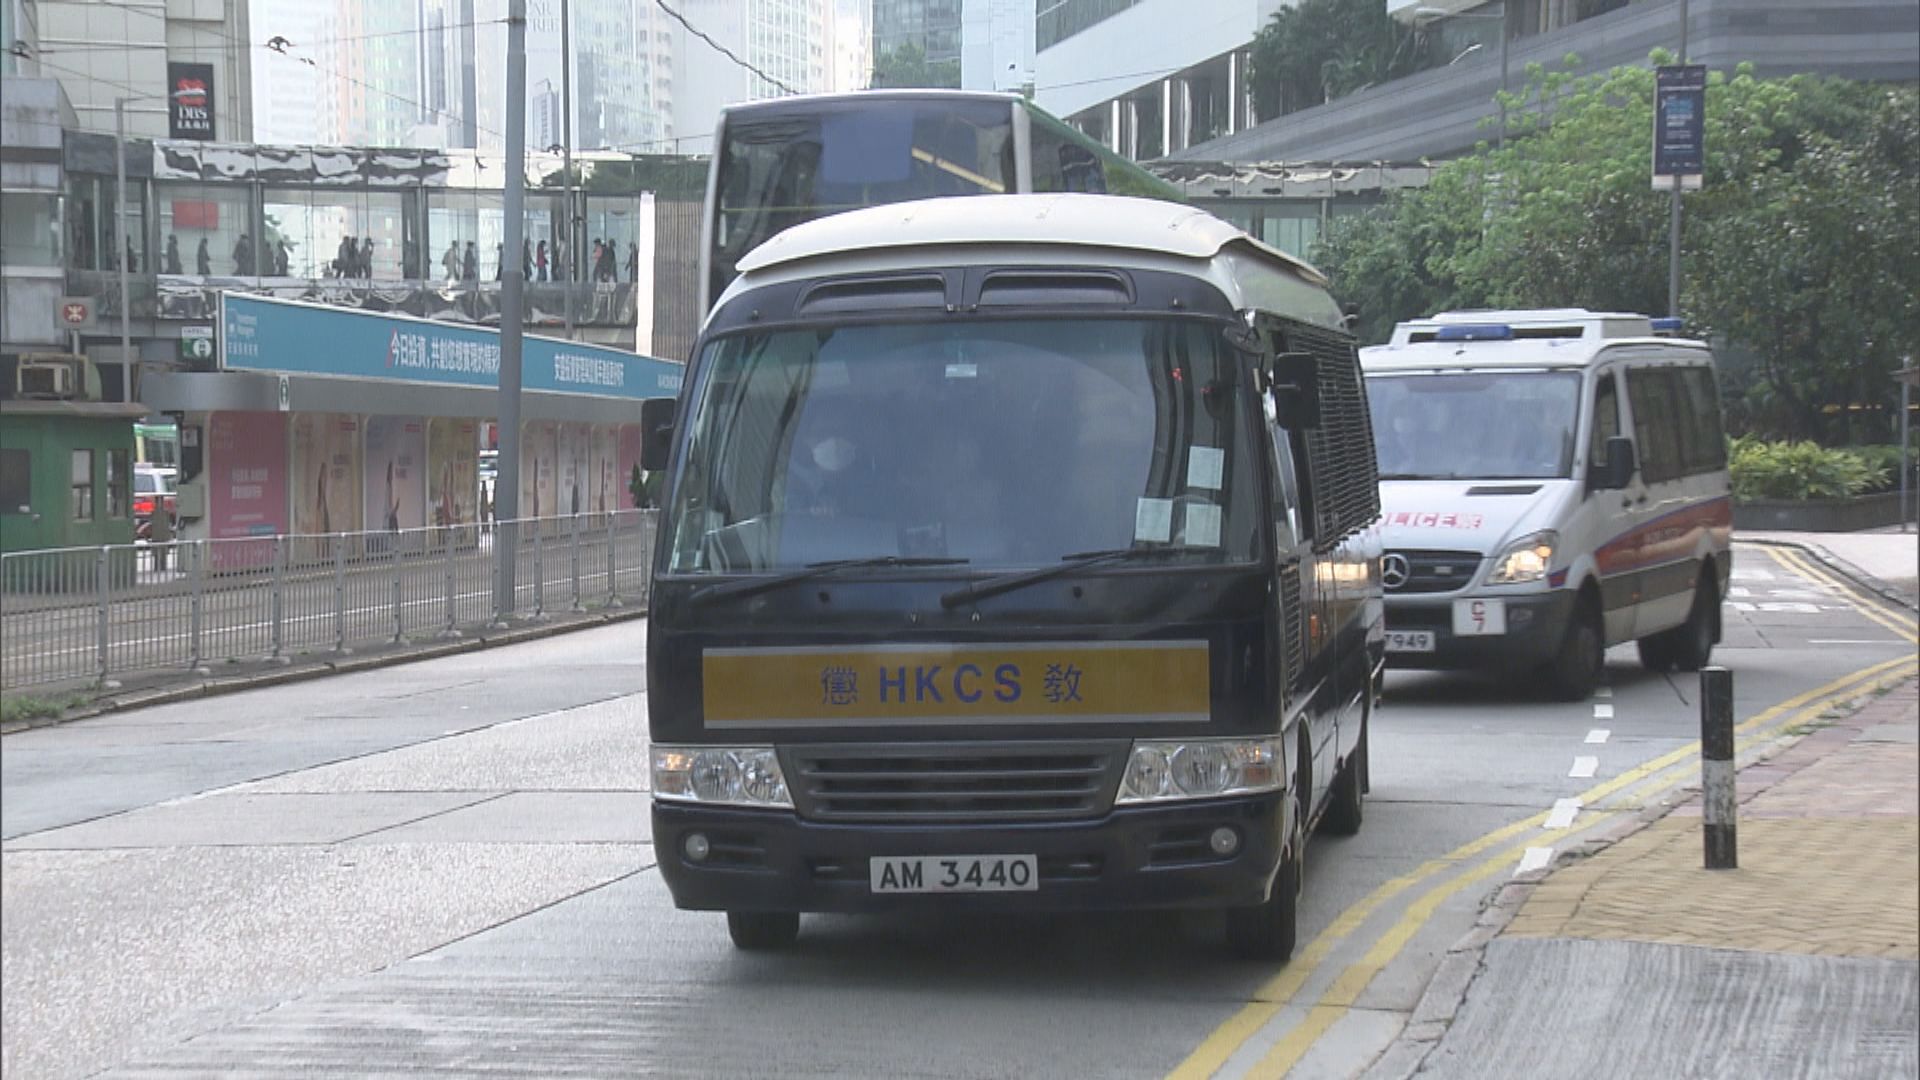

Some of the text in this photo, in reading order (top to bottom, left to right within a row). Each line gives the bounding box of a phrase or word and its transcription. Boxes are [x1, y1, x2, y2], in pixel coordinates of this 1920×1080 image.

[178, 106, 207, 119] DBS
[879, 663, 1021, 703] HKCS
[880, 859, 1030, 889] AM 3440
